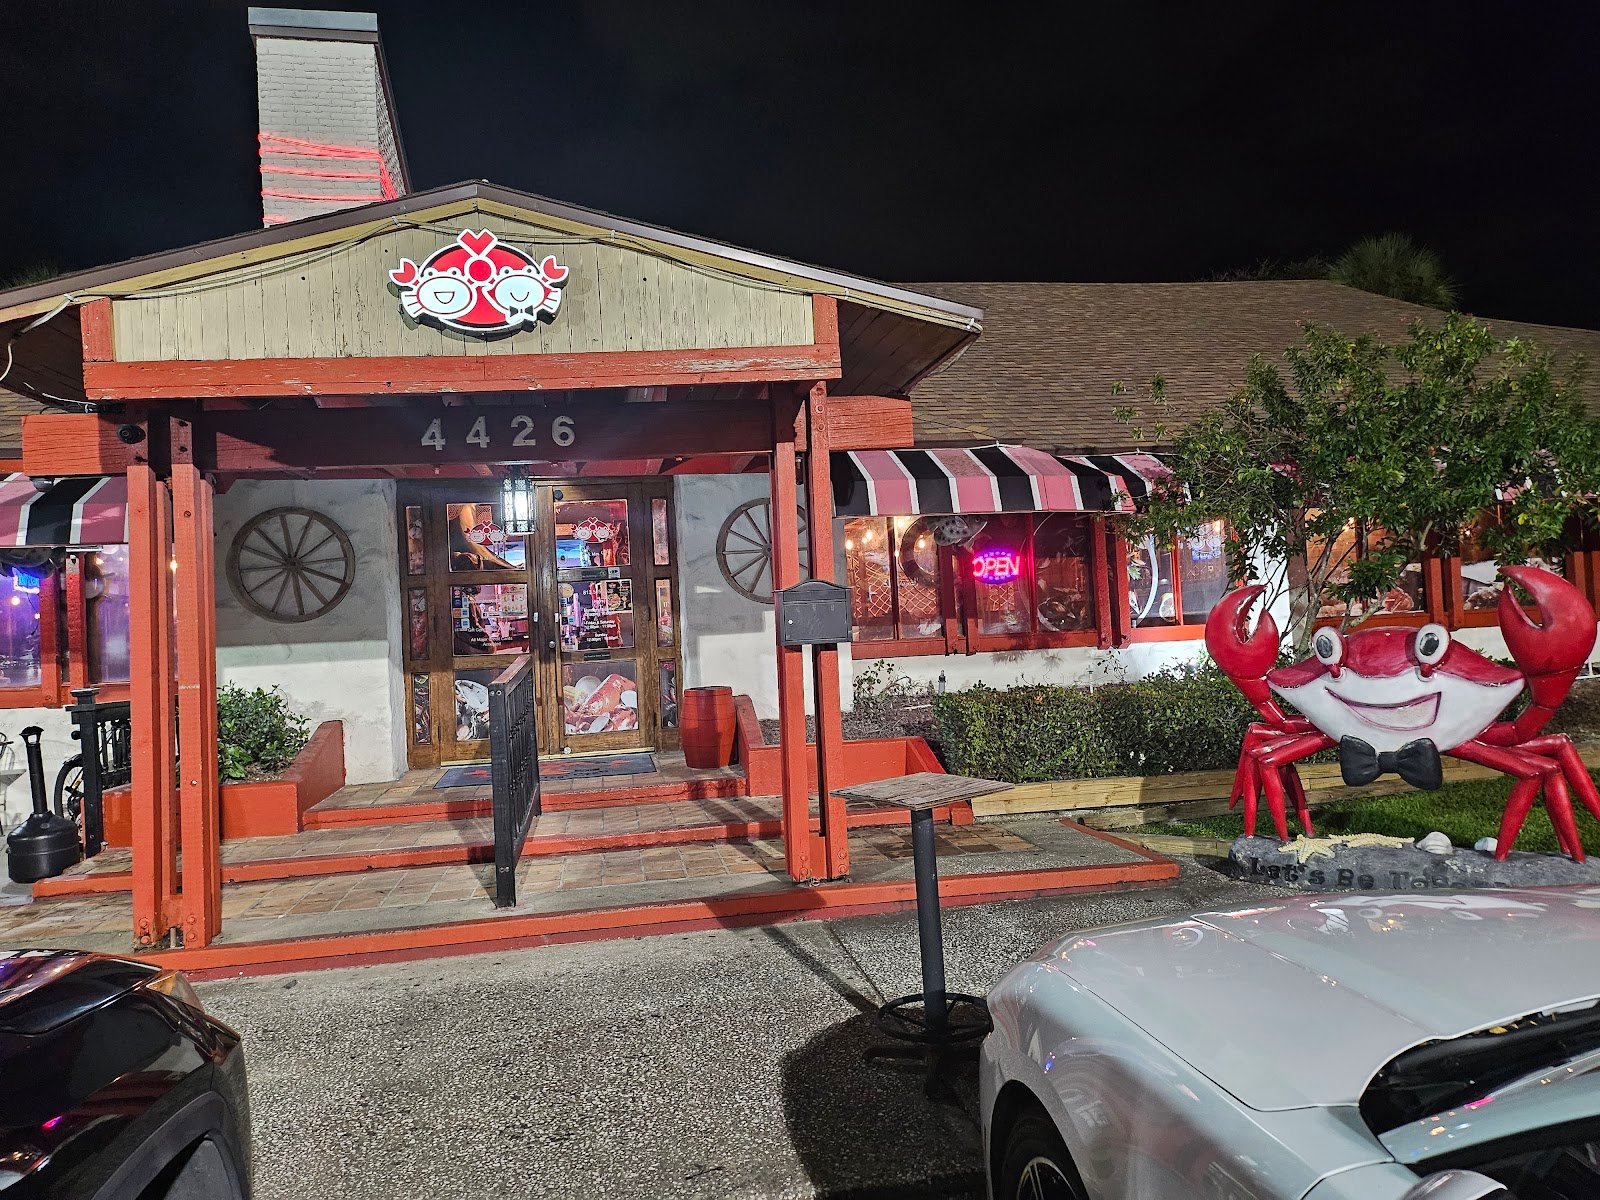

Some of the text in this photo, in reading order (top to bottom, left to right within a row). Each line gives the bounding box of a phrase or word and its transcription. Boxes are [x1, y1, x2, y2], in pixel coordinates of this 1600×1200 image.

[421, 415, 575, 450] 4426
[972, 555, 1020, 577] OPEN
[1338, 868, 1375, 889] Be
